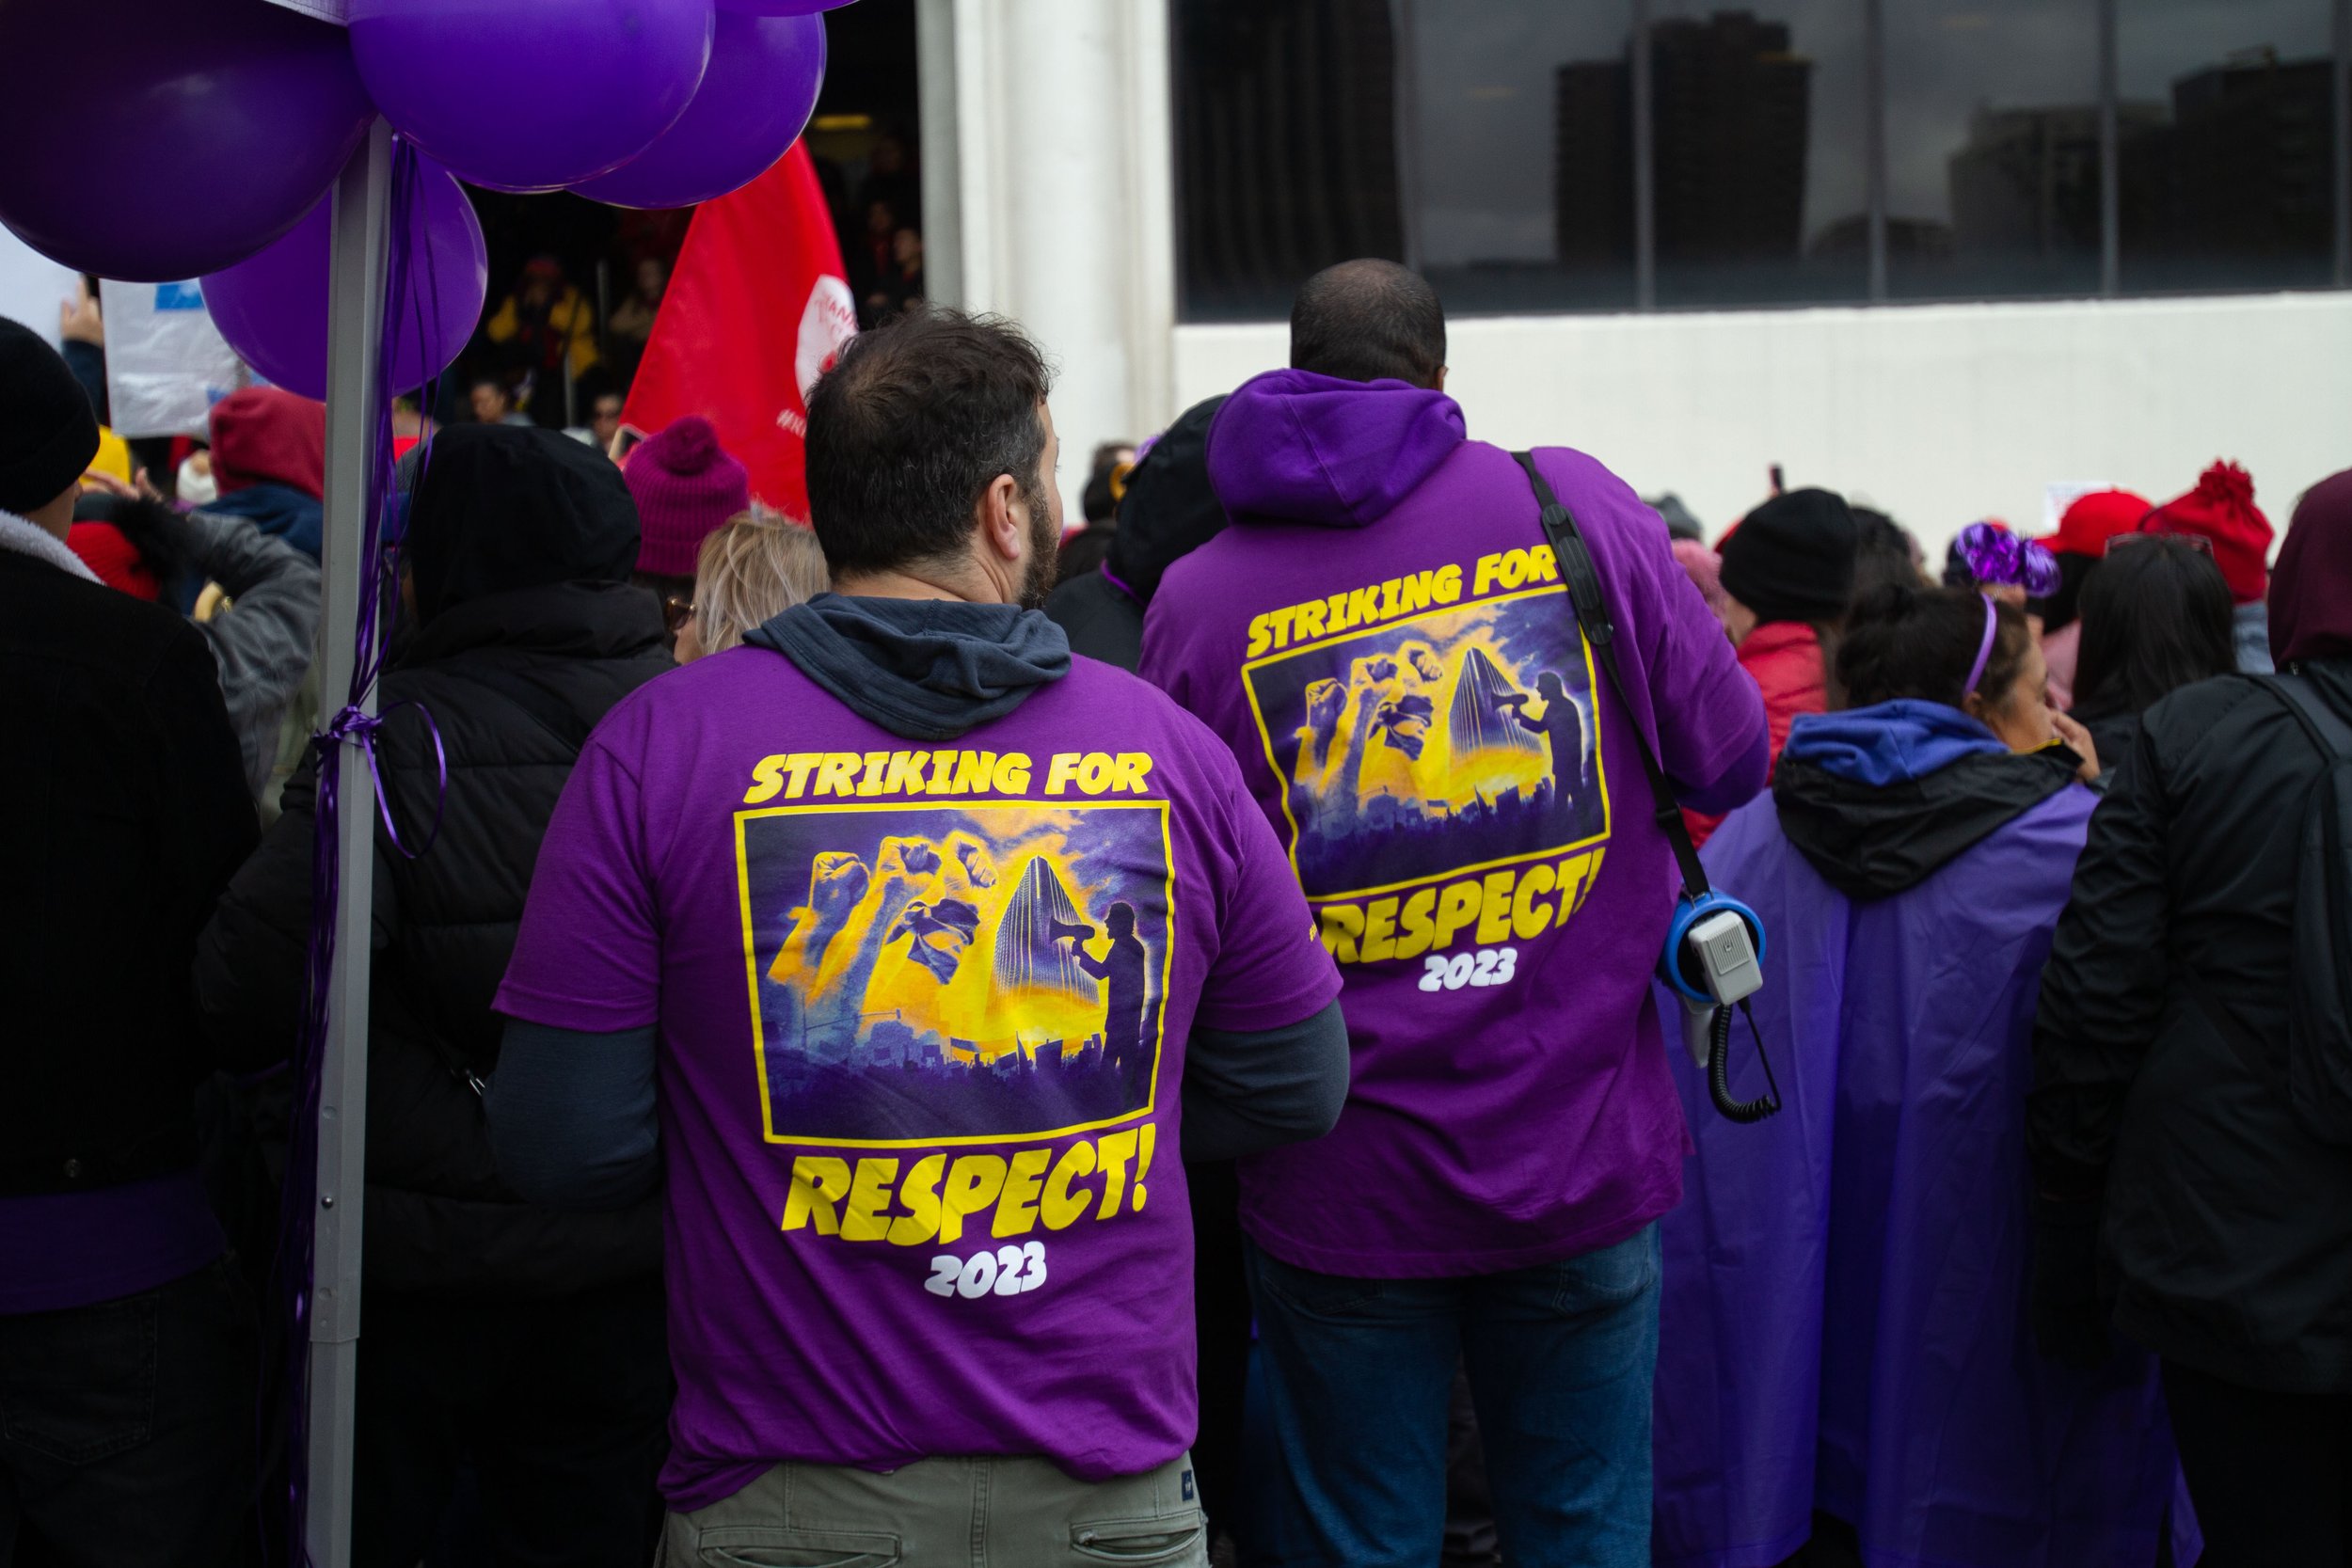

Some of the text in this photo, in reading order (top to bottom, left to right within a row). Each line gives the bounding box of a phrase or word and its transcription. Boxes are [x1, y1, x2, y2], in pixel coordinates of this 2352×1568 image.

[1247, 545, 1558, 658] STRIKING FOR
[743, 750, 1153, 803] STRIKING FOR
[1320, 847, 1607, 964] RESPECT!
[1418, 947, 1518, 992] 2023
[781, 1122, 1156, 1246] RESPECT!
[924, 1241, 1048, 1300] 2023
